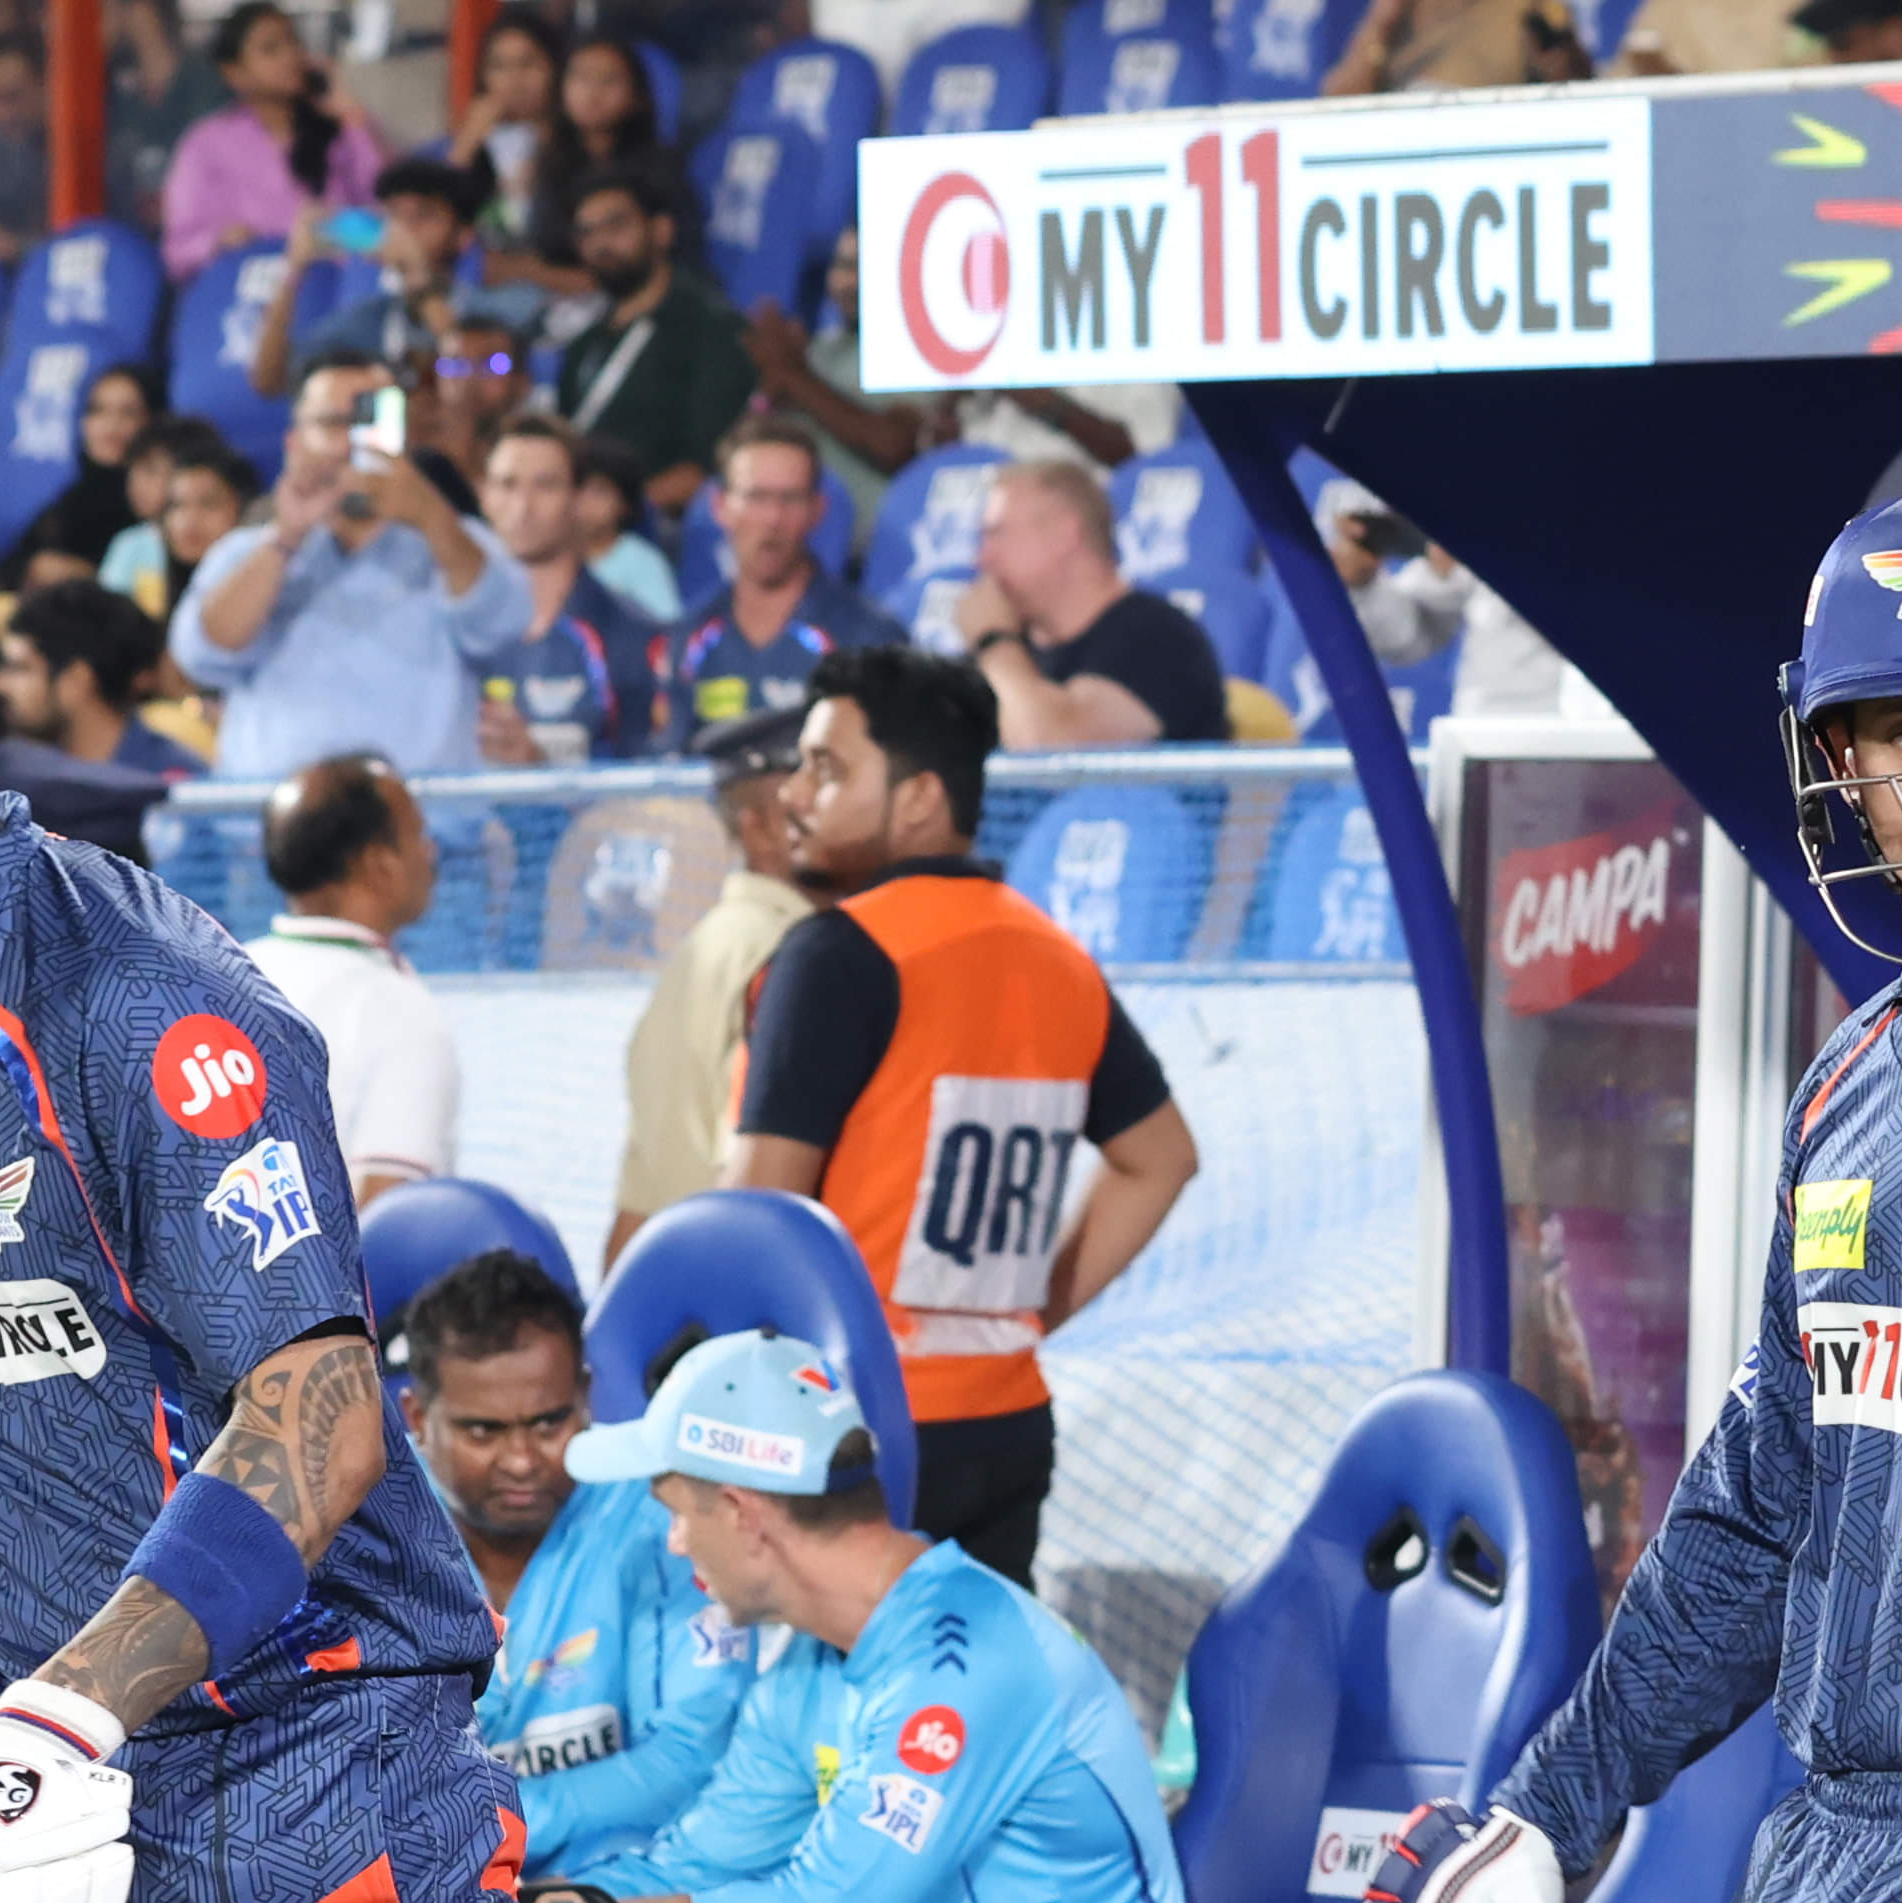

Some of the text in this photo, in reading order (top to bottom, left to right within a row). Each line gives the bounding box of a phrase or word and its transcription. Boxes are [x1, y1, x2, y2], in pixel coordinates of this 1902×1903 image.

[1503, 839, 1670, 968] CAMPA
[180, 1043, 256, 1117] Jio
[272, 1190, 310, 1239] IP
